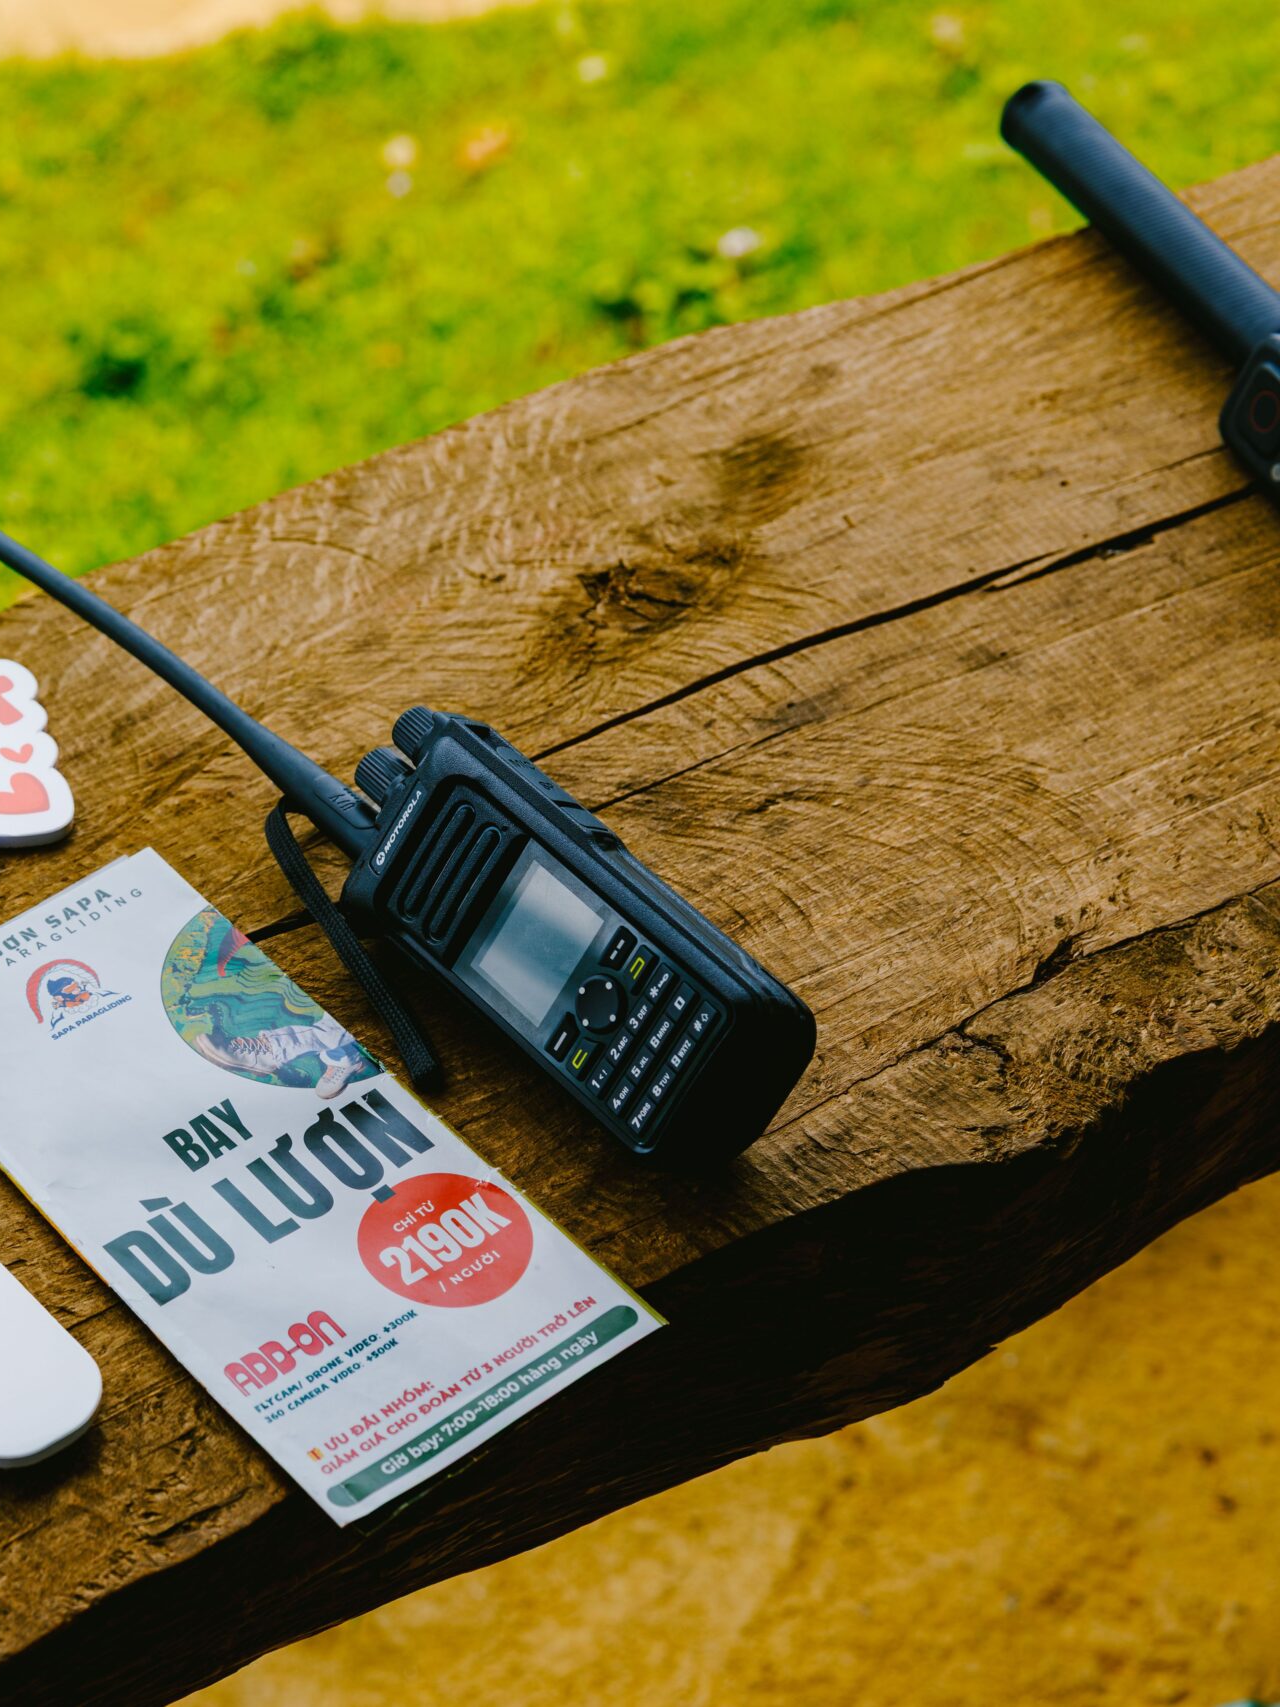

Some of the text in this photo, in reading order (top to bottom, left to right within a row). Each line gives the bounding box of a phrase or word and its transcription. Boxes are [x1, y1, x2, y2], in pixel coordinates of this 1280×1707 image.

[384, 790, 422, 853] MOTOROLA
[44, 888, 112, 929] SAPA
[51, 994, 133, 1041] SAPA PARAGLIDING
[629, 1004, 648, 1030] 3 DEF
[657, 1021, 670, 1040] MNO
[610, 1036, 629, 1060] 2 ABC
[631, 1056, 649, 1078] 5 JKL
[678, 1039, 692, 1059] WXYZ
[591, 1079, 600, 1089] 1
[612, 1086, 629, 1109] 4 GHI
[652, 1073, 670, 1097] 8 TUV
[631, 1102, 652, 1129] 7 PQRS
[162, 1098, 254, 1173] BAY
[102, 1087, 436, 1307] DÙ LƯỢN
[393, 1200, 436, 1232] CHỈ TỪ
[379, 1192, 513, 1286] 2190K
[449, 1250, 501, 1285] NGƯỜI
[254, 1309, 418, 1413] FLYCAM/ DRONE VIDEO: +300K
[264, 1337, 399, 1424] 360 CAMERA VIDEO: +500K
[320, 1296, 598, 1475] GIẢM GIÁ CHO ĐOÀN TỪ 3 NGƯỜI TRỞ LÊN
[324, 1379, 436, 1452] ƯU ĐÃI NHÓM:
[380, 1331, 600, 1475] Giờ bay: 7:00~18:00 hàng ngày
